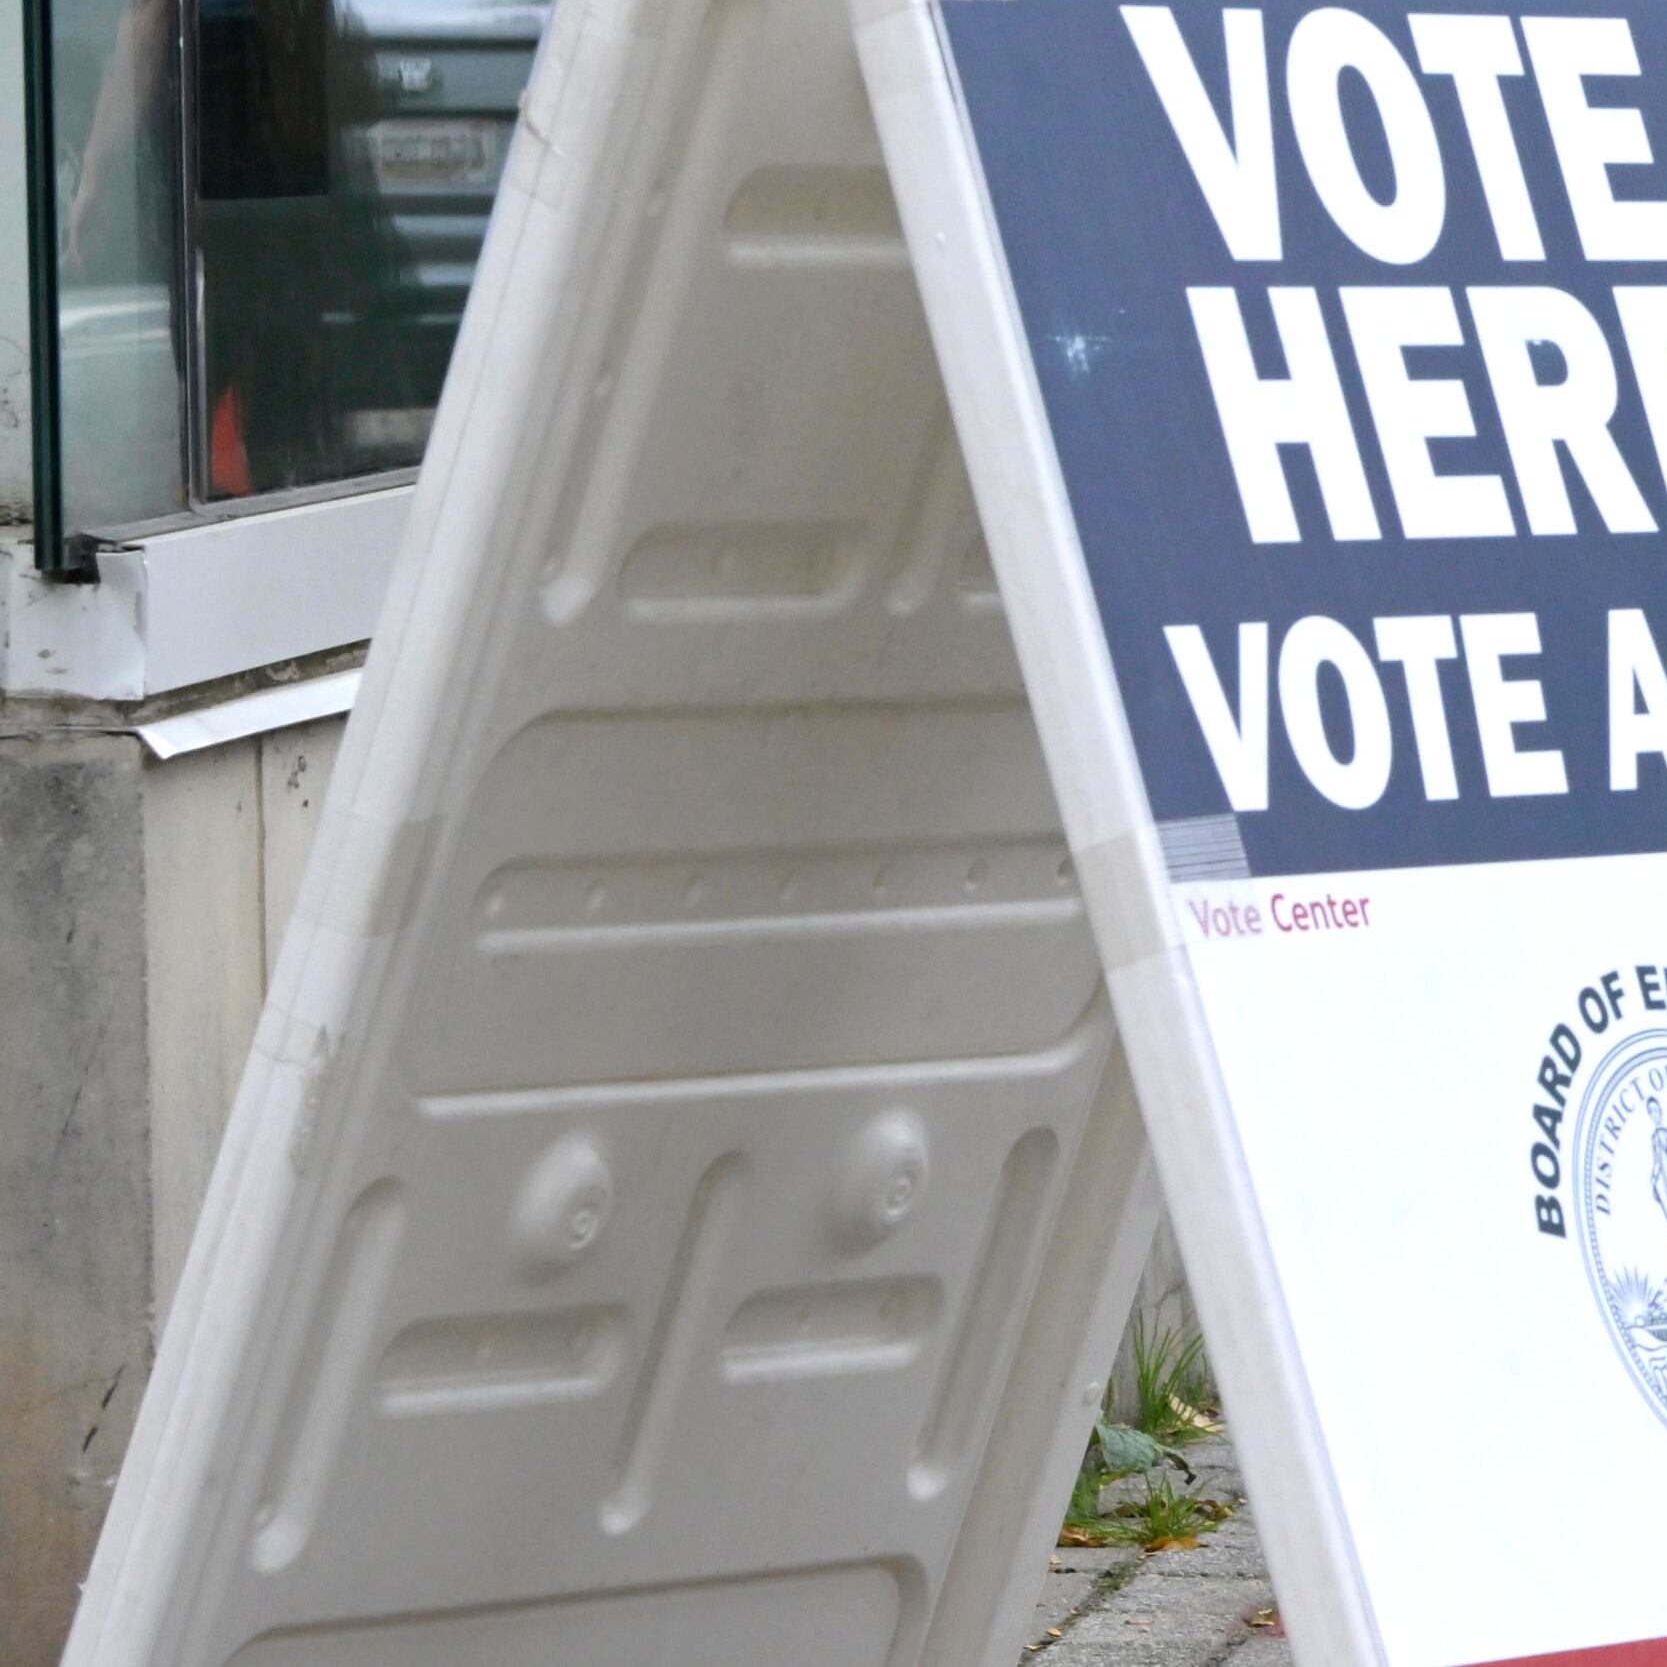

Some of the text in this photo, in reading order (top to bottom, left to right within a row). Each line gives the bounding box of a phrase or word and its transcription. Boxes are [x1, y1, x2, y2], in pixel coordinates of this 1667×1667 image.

[1163, 612, 1570, 812] VOTE
[1187, 892, 1371, 938] Vote Center
[1530, 1022, 1583, 1239] BOARD
[1577, 970, 1625, 1035] OF
[1594, 1075, 1651, 1216] DISTRICT
